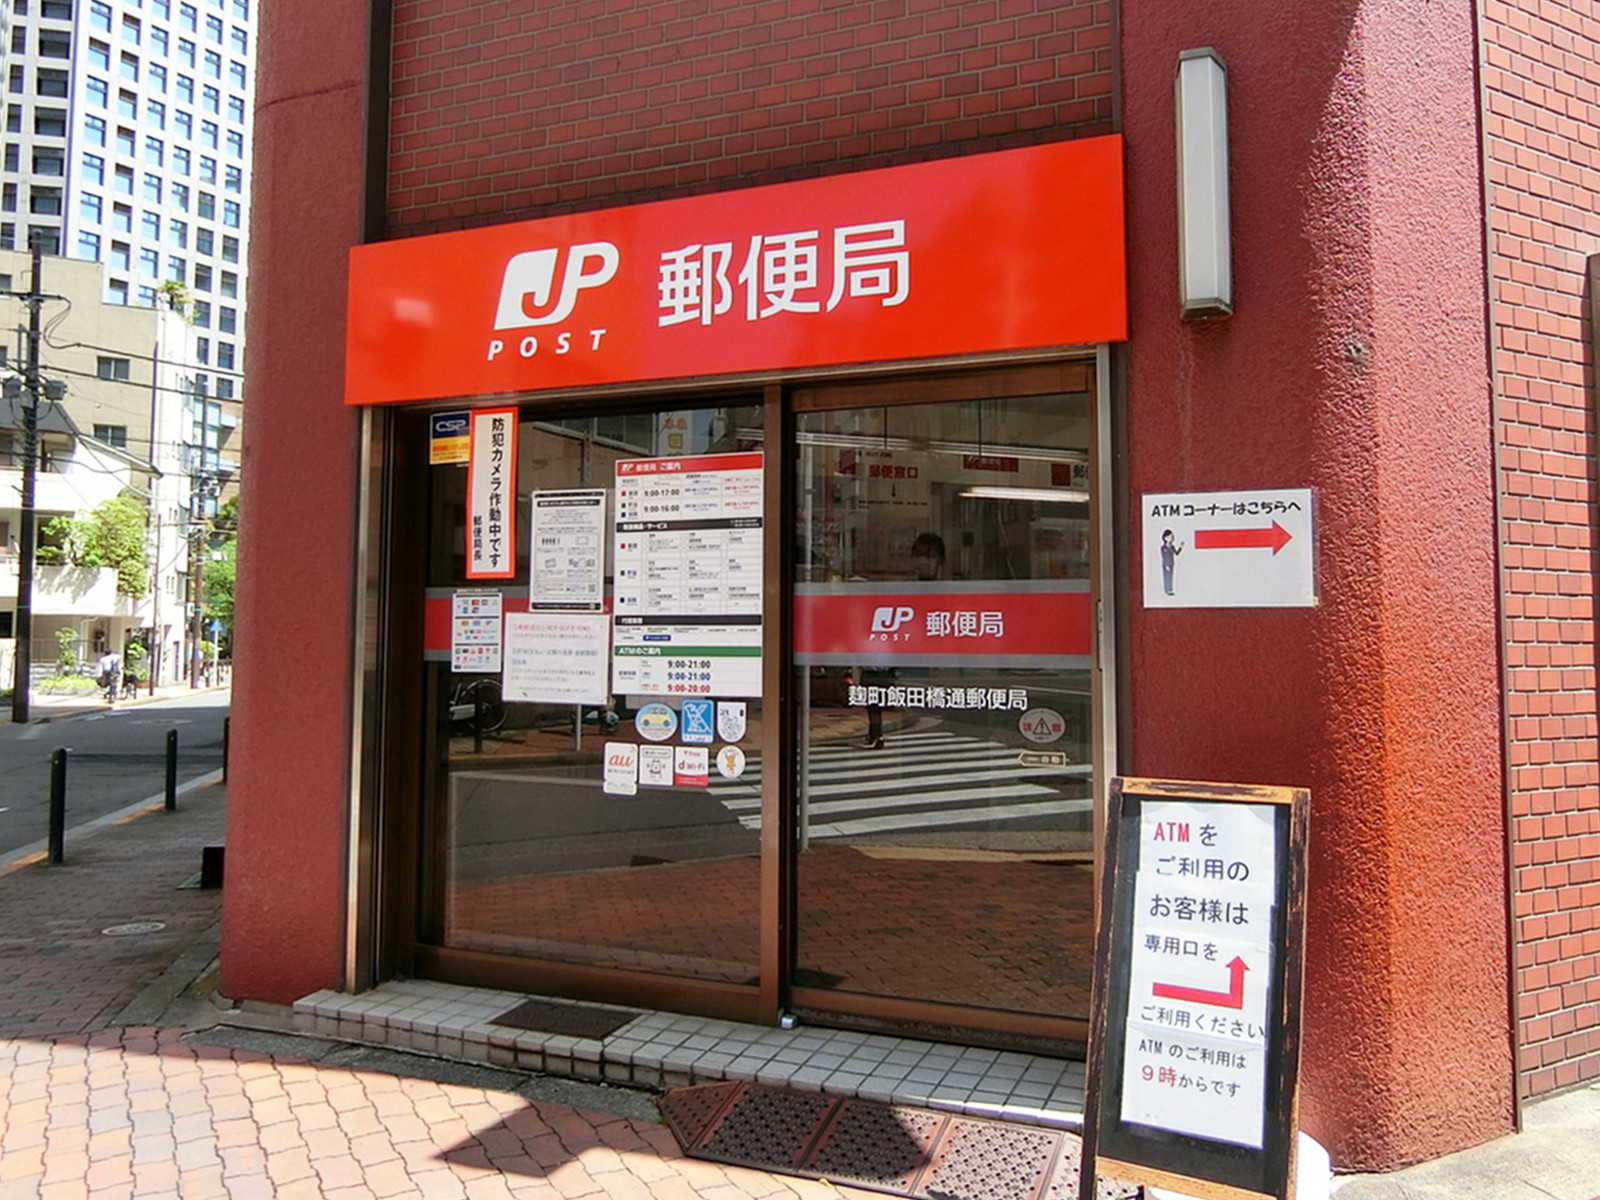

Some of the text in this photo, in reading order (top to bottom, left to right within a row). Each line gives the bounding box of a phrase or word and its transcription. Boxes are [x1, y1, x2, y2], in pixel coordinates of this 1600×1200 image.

[658, 219, 910, 326] 郵便局
[488, 329, 607, 361] POST
[436, 419, 467, 432] CSP
[869, 464, 918, 479] 郵便窓口
[489, 418, 505, 569] 防犯カメラ作動中です
[473, 515, 483, 561] 郵便局長
[869, 633, 911, 641] POST
[926, 611, 1004, 637] 郵便局
[667, 660, 711, 669] 9:00-21:00
[667, 672, 711, 681] 9:00-21:00
[667, 684, 711, 693] 9:00-20:00
[608, 754, 635, 767] au
[1154, 822, 1218, 846] ATM を
[1156, 855, 1249, 881] ご利用の
[1149, 894, 1249, 925] お客様は
[1144, 934, 1218, 962] 専用口を
[1140, 1005, 1268, 1039] ご利用ください
[1169, 1044, 1247, 1069] のご利用は
[1141, 1065, 1241, 1098] 9時からです
